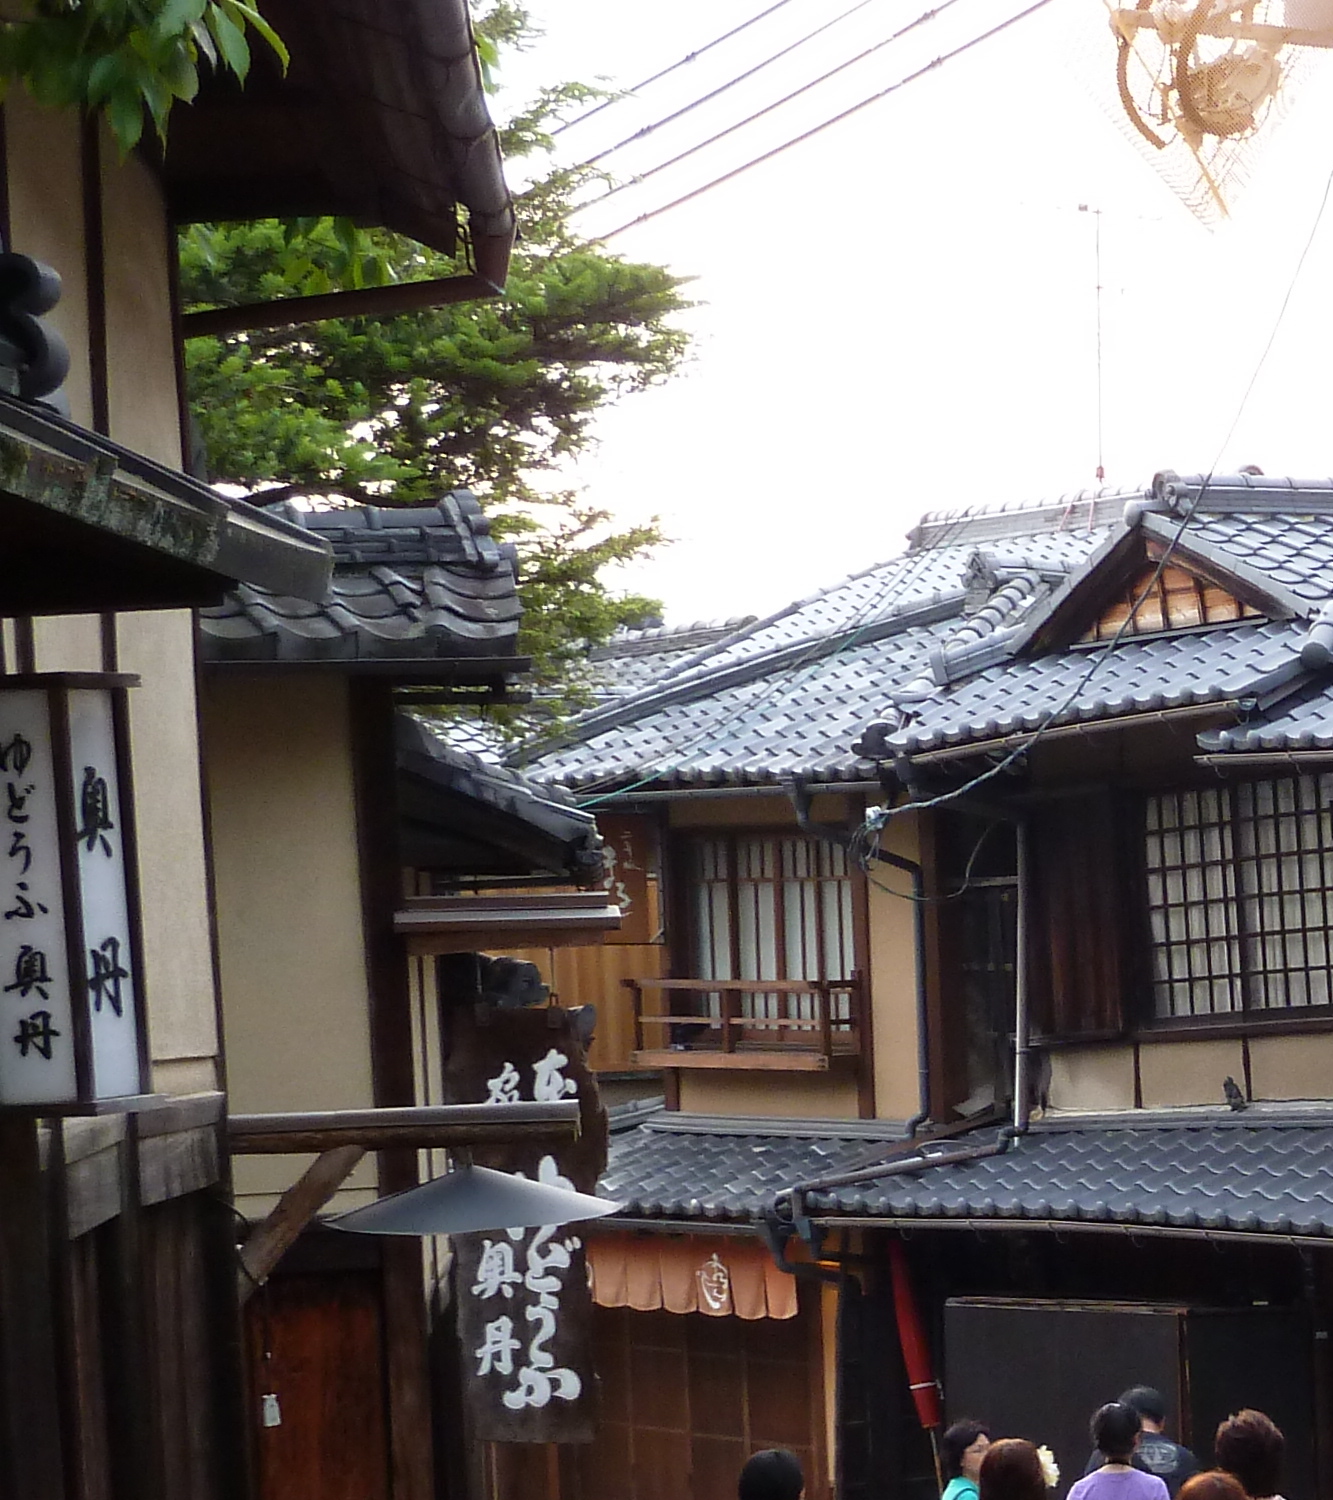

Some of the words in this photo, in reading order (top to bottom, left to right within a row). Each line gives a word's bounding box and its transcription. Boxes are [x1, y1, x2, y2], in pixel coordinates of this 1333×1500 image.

[0, 732, 48, 920] ゆどうふ
[77, 765, 130, 1019] 奥丹
[4, 944, 61, 1061] 奥丹
[471, 1239, 524, 1376] 奥丹
